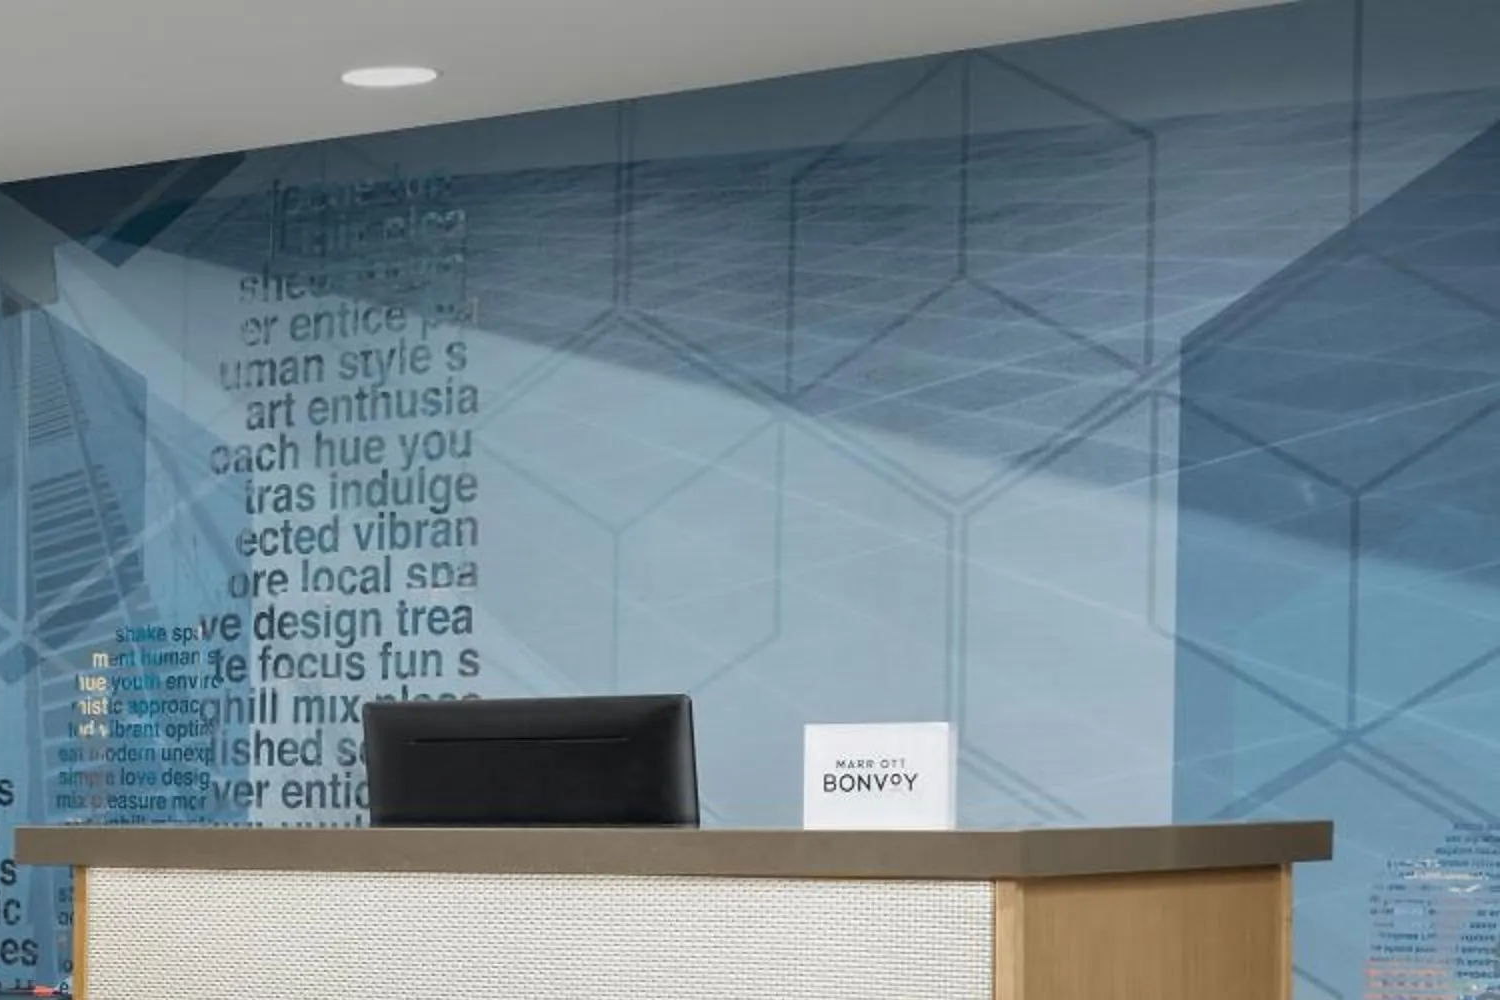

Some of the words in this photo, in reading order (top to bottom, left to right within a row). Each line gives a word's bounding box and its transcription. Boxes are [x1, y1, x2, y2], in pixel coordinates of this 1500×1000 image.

[289, 304, 406, 342] entice
[338, 338, 432, 388] style
[307, 378, 479, 426] enthusia
[314, 431, 386, 469] hue
[399, 429, 473, 471] you
[329, 465, 478, 514] indulge
[353, 511, 480, 551] vibran
[300, 556, 392, 595] local
[253, 603, 383, 649] design
[397, 600, 474, 638] trea
[258, 646, 366, 683] focus
[380, 642, 444, 680] fun
[294, 694, 360, 724] mix
[823, 773, 919, 793] BONVOY
